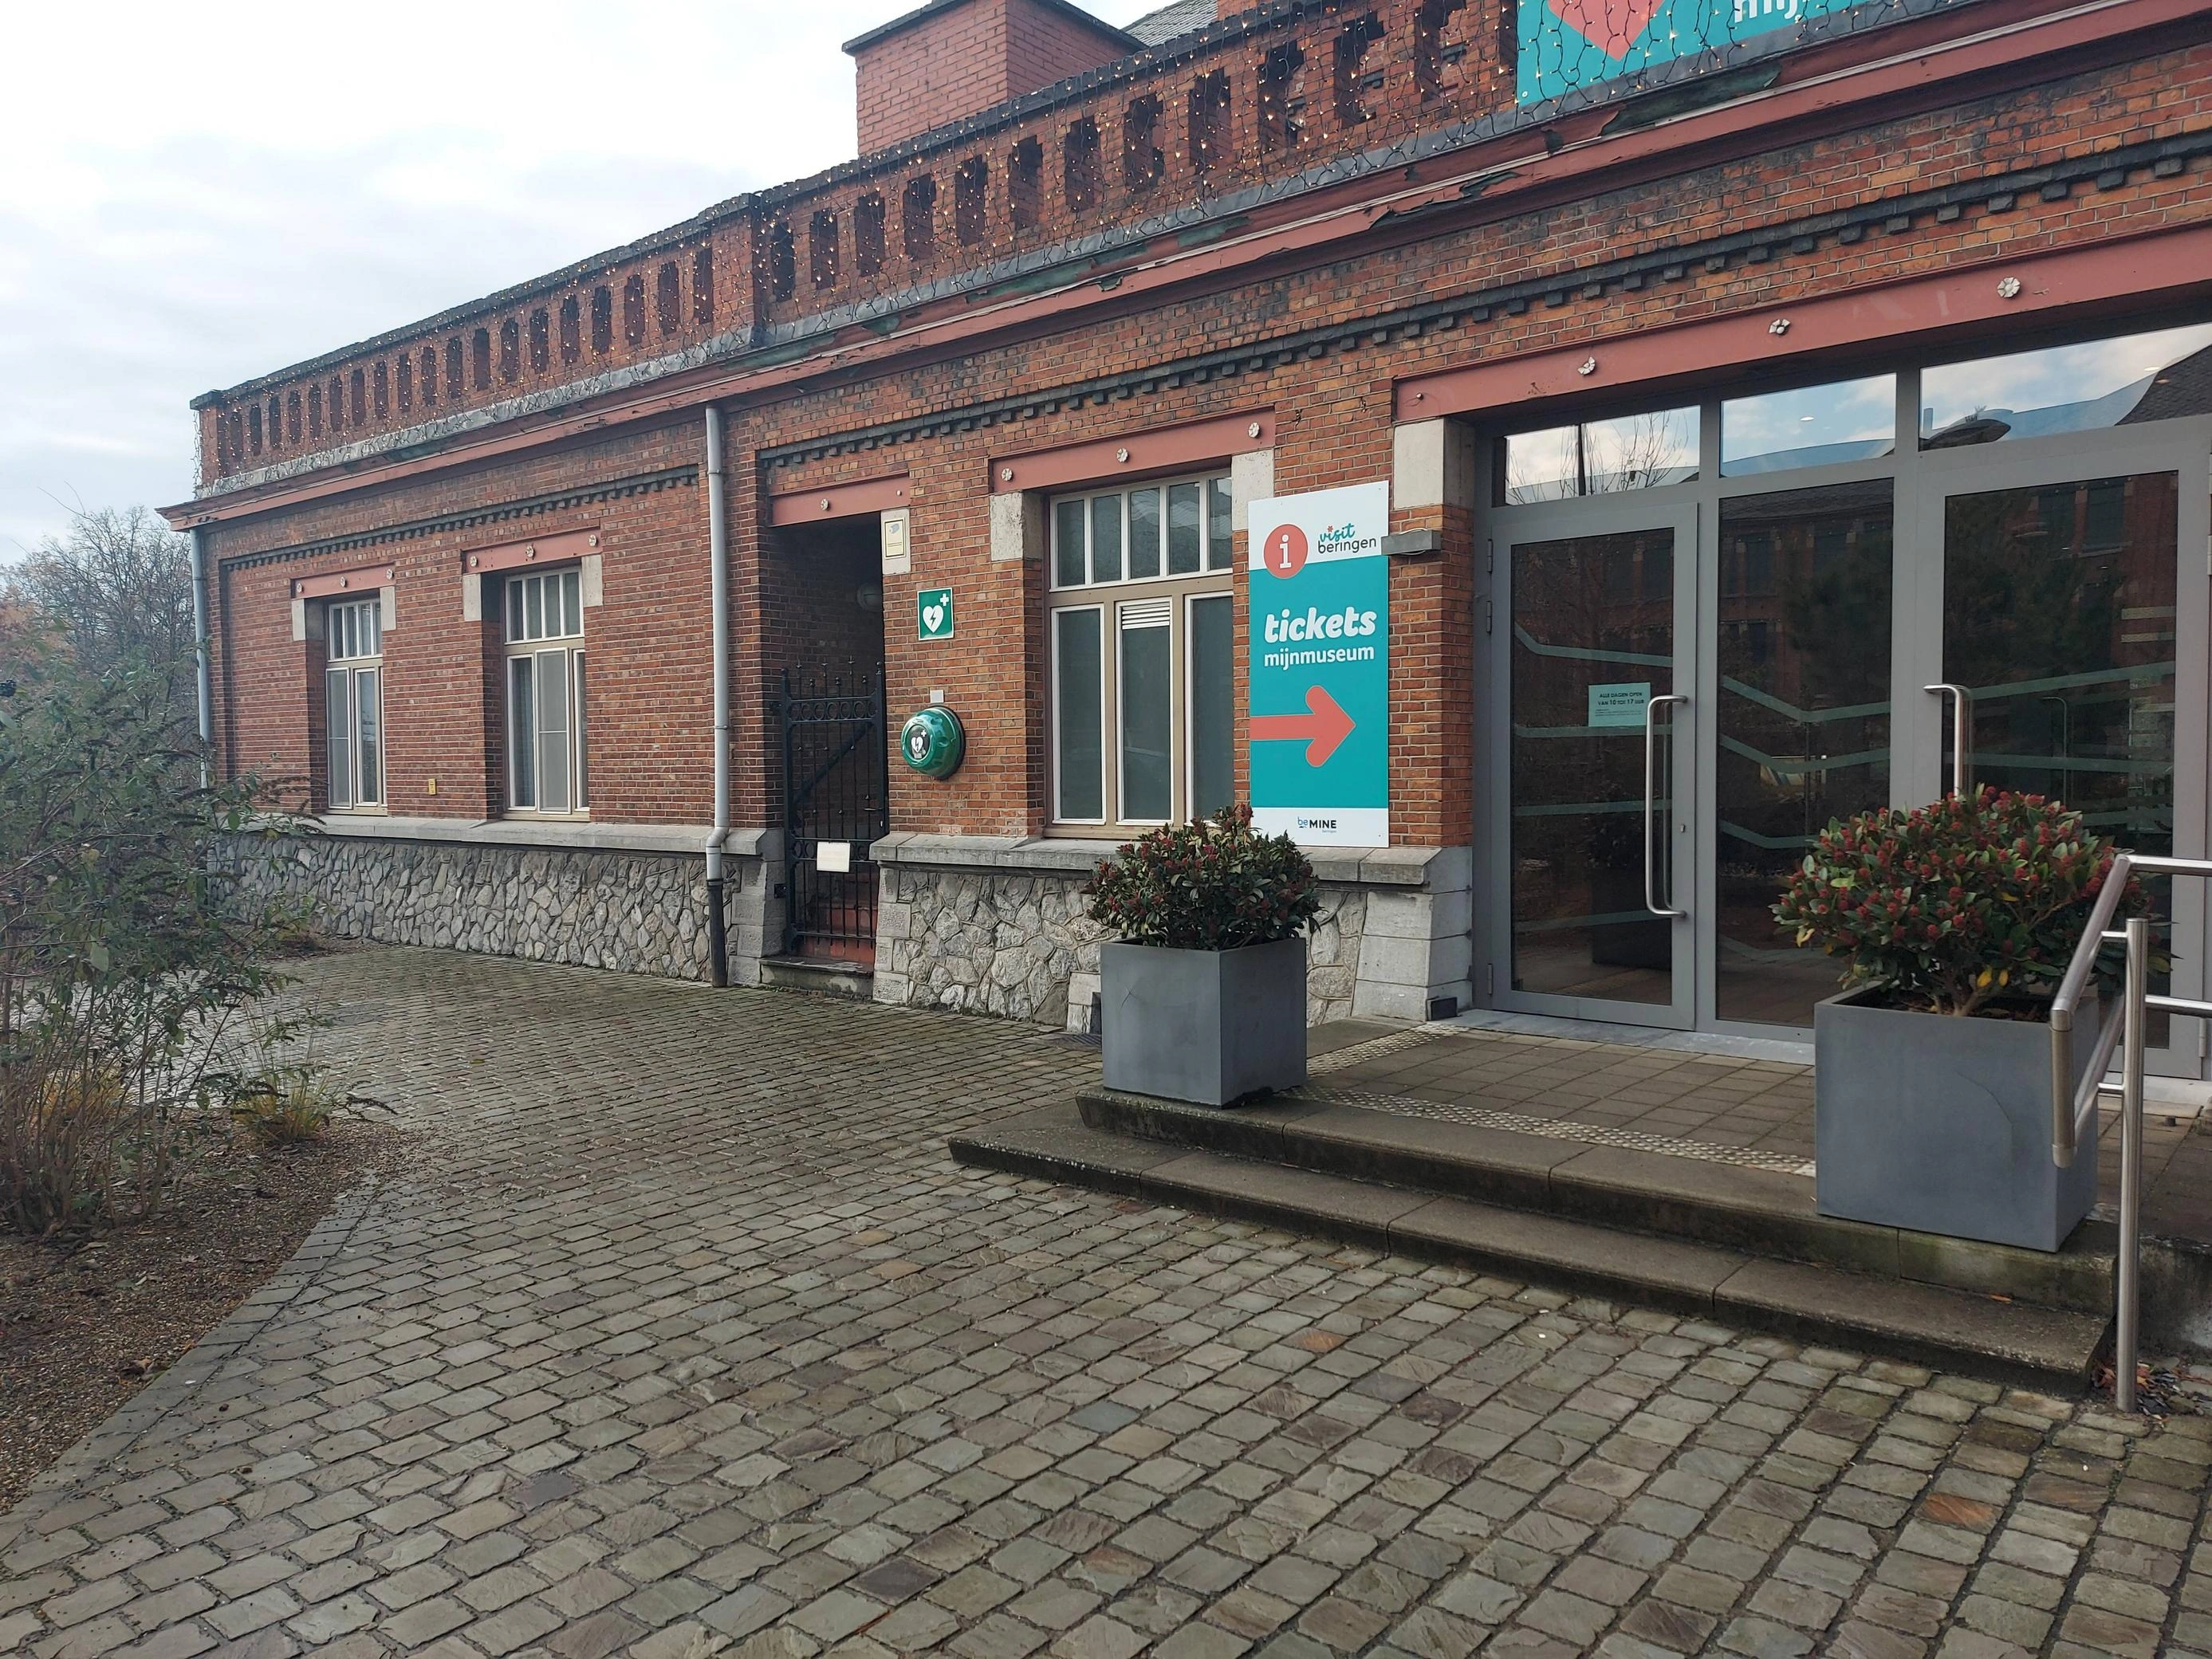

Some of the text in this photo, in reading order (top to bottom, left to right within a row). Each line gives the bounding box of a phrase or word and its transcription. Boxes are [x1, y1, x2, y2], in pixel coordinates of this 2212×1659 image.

[1320, 523, 1355, 543] visit
[1279, 534, 1292, 569] i
[1317, 537, 1376, 554] beringen
[1264, 606, 1377, 643] tickets
[1264, 646, 1375, 670] mijnmuseum
